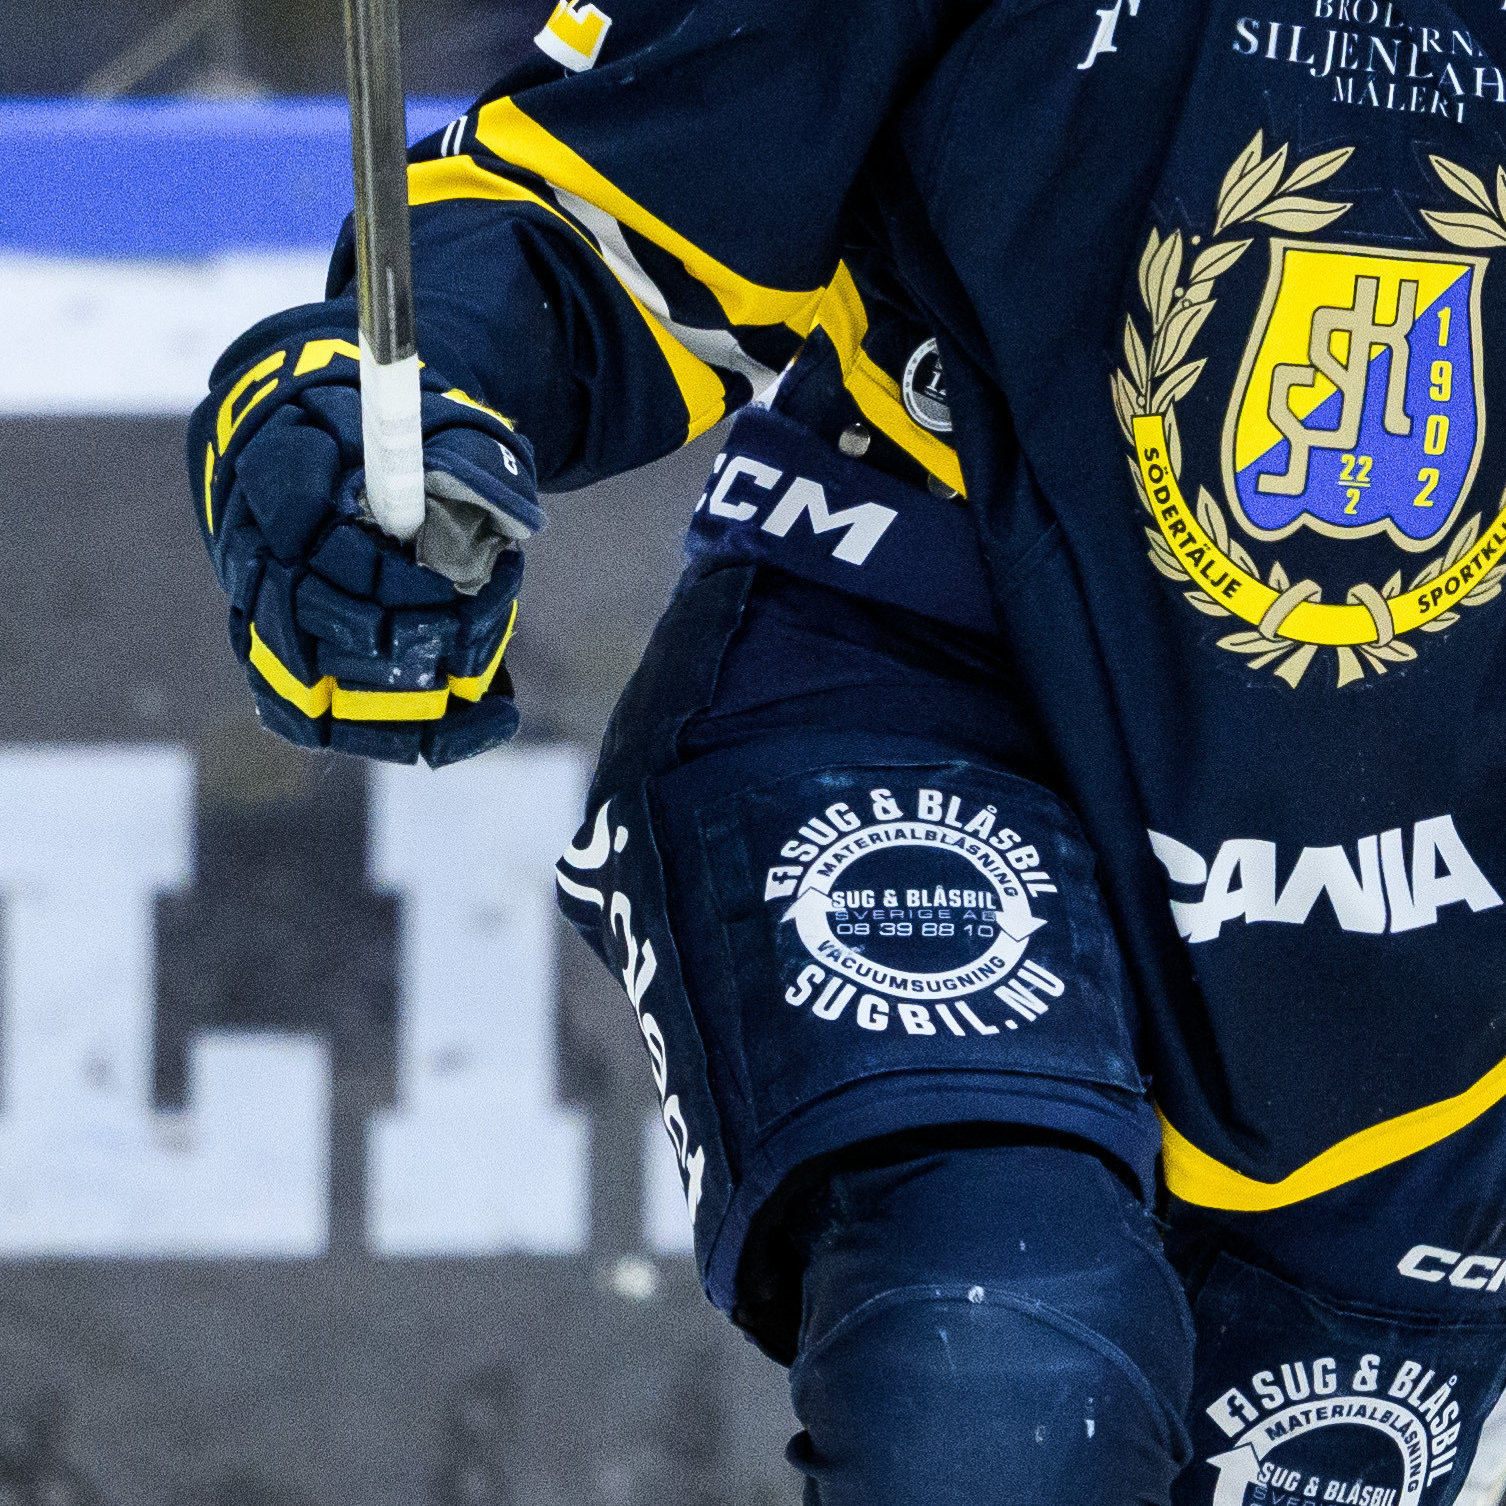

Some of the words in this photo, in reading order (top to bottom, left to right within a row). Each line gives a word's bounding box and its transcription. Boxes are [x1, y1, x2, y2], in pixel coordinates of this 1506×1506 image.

[1412, 306, 1454, 508] 1902
[1338, 454, 1374, 483] 22
[1143, 445, 1243, 600] SÖDERTÄLJE
[1344, 487, 1360, 516] 2
[780, 801, 862, 864] SUG
[869, 788, 904, 821] &
[917, 788, 1059, 899] BLÅSBIL
[816, 827, 1020, 898] MATERIALBLÅSNING
[830, 889, 875, 910] SUG
[882, 890, 899, 908] &
[906, 884, 997, 910] BLÅSBIL
[834, 908, 952, 922] SVERIGE
[836, 922, 871, 936] 08
[878, 922, 913, 937] 39
[920, 923, 956, 937] 88
[963, 923, 995, 939] 10
[817, 938, 1007, 993] VACUUMSUGNING
[784, 958, 1066, 1037] SUGBIL.NU
[1251, 1356, 1338, 1410] SUG
[1352, 1353, 1381, 1393] &
[1387, 1359, 1462, 1488] BLÅSBIL
[1264, 1402, 1422, 1493] MATERIALBLÅSNING
[1258, 1461, 1302, 1493] SUG
[1303, 1475, 1320, 1497] &
